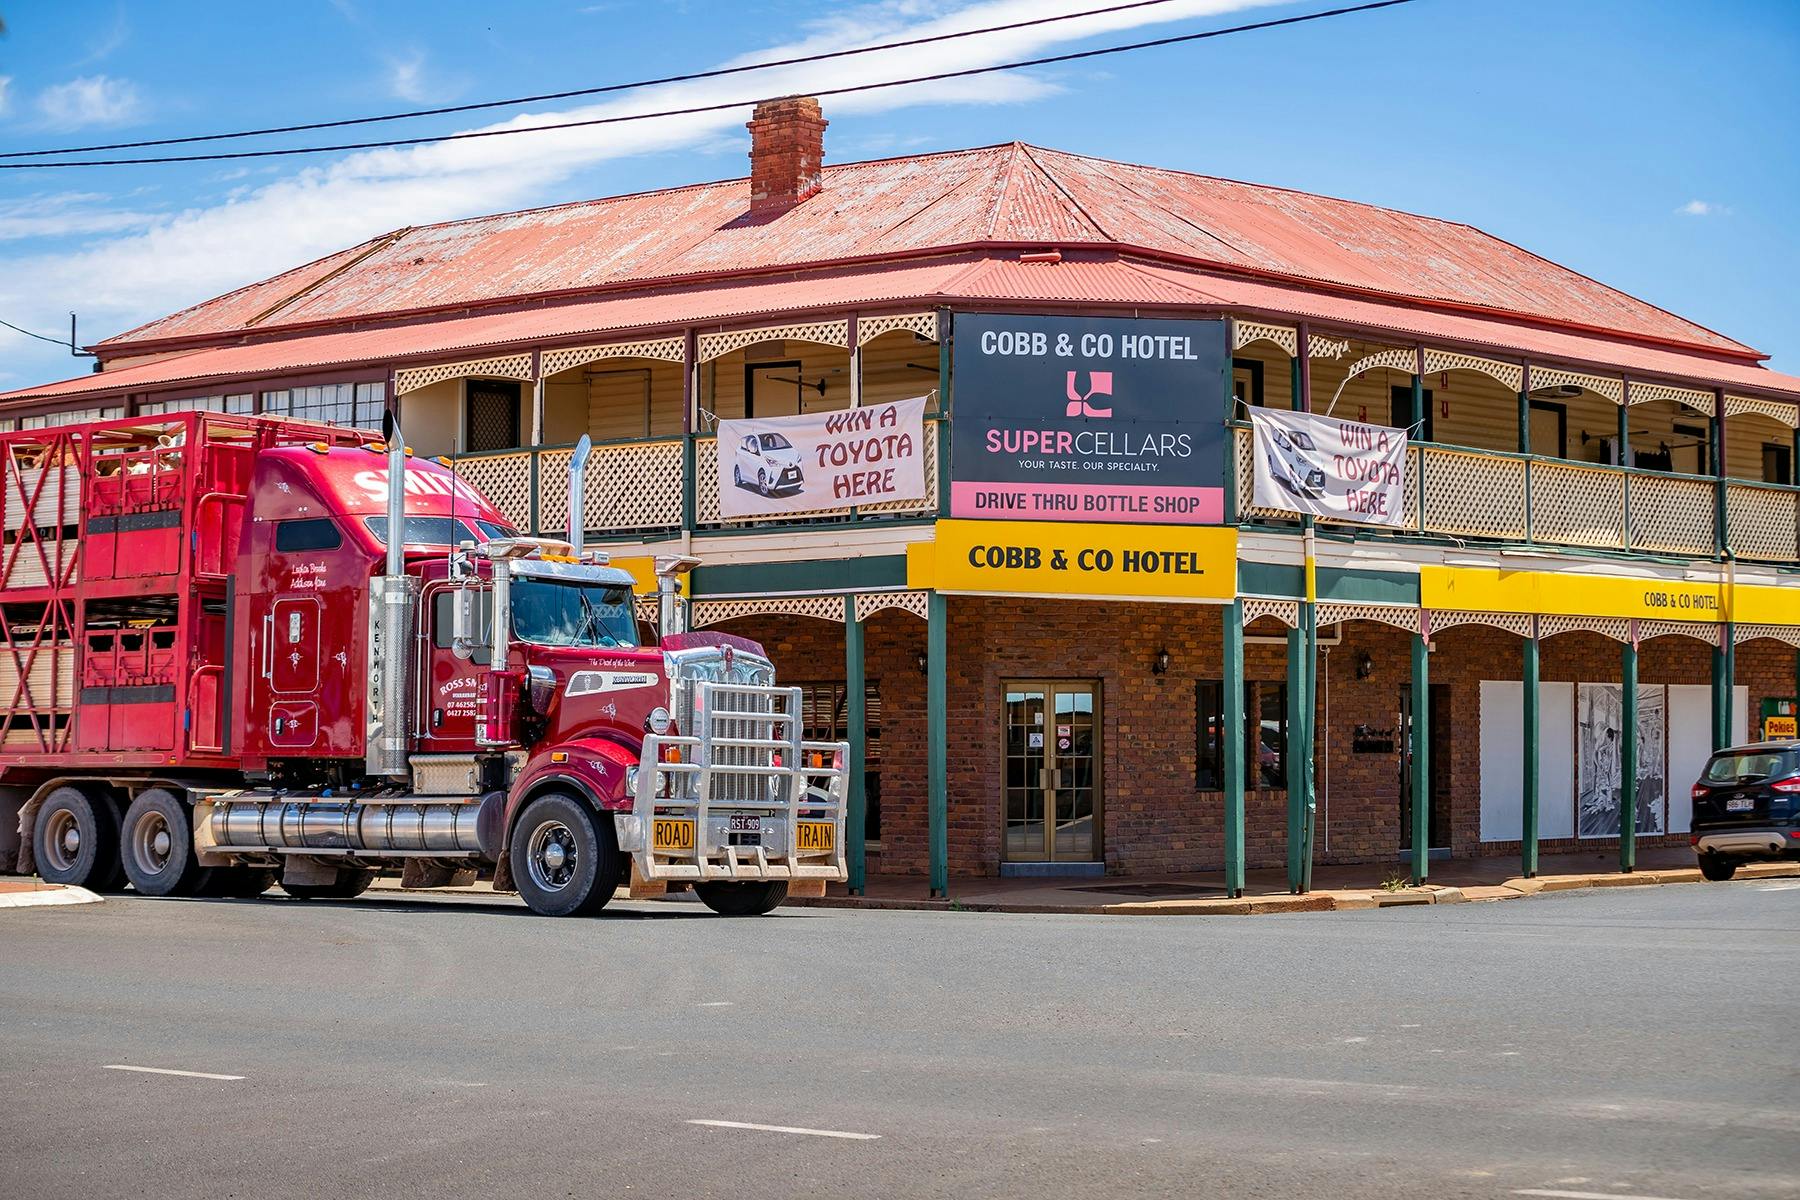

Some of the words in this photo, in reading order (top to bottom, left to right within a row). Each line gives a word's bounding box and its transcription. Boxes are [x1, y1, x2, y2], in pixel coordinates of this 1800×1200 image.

[981, 331, 1048, 356] COBB
[1054, 333, 1074, 357] &
[1081, 333, 1114, 358] CO
[1122, 335, 1198, 360] HOTEL
[824, 408, 875, 435] WIN
[880, 405, 897, 428] A
[816, 432, 913, 468] TOYOTA
[986, 429, 1192, 458] SUPERCELLARS
[1339, 423, 1372, 450] WIN
[1377, 430, 1390, 453] A
[1018, 460, 1045, 469] YOUR
[1048, 461, 1080, 470] TASTE.
[1082, 462, 1104, 470] OUR
[1106, 462, 1160, 472] SPECIALTY.
[1333, 454, 1400, 486] TOYOTA
[832, 468, 896, 500] HERE
[975, 492, 1027, 510] DRIVE
[1032, 493, 1078, 511] THRU
[1084, 494, 1149, 512] BOTTLE
[1153, 496, 1200, 514] SHOP
[1345, 488, 1388, 516] HERE
[968, 545, 1042, 569] COBB
[1050, 549, 1068, 571] &
[1077, 549, 1114, 572] CO
[1122, 550, 1205, 575] HOTEL
[1644, 592, 1668, 607] COBB
[1670, 594, 1676, 608] &
[1678, 594, 1690, 608] CO
[1693, 594, 1719, 610] HOTEL
[372, 620, 380, 723] KENWORTH
[440, 678, 464, 696] ROSS
[656, 822, 690, 846] ROAD
[797, 824, 832, 849] TRAIN
